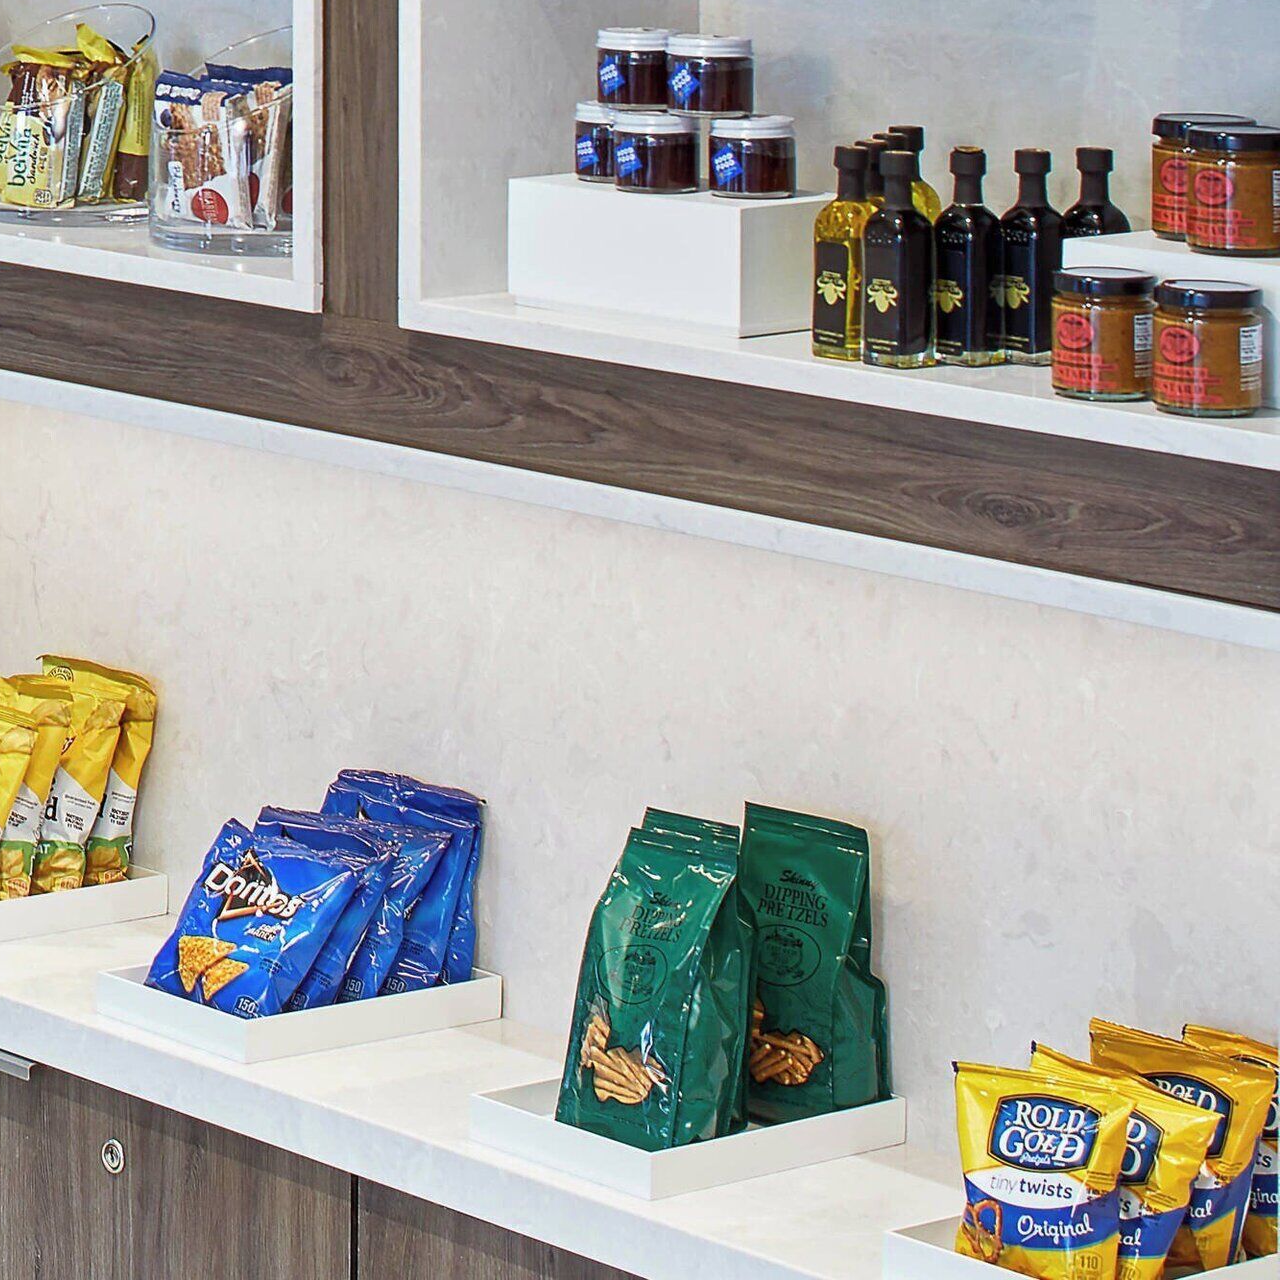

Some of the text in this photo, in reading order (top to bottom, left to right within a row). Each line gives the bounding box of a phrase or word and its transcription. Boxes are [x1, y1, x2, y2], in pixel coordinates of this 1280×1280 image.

[204, 863, 304, 919] Doritos
[779, 869, 818, 891] Skinny
[764, 883, 829, 911] DIPPING
[757, 898, 829, 928] PRETZELS
[618, 918, 683, 943] PRETZELS
[344, 981, 362, 993] 150
[387, 980, 405, 992] 150
[237, 998, 255, 1013] 150
[1015, 1100, 1088, 1132] ROLD
[999, 1127, 1086, 1163] GOLD
[990, 1175, 1073, 1199] tiny twists
[1017, 1215, 1094, 1245] Original
[1079, 1254, 1099, 1270] 110
